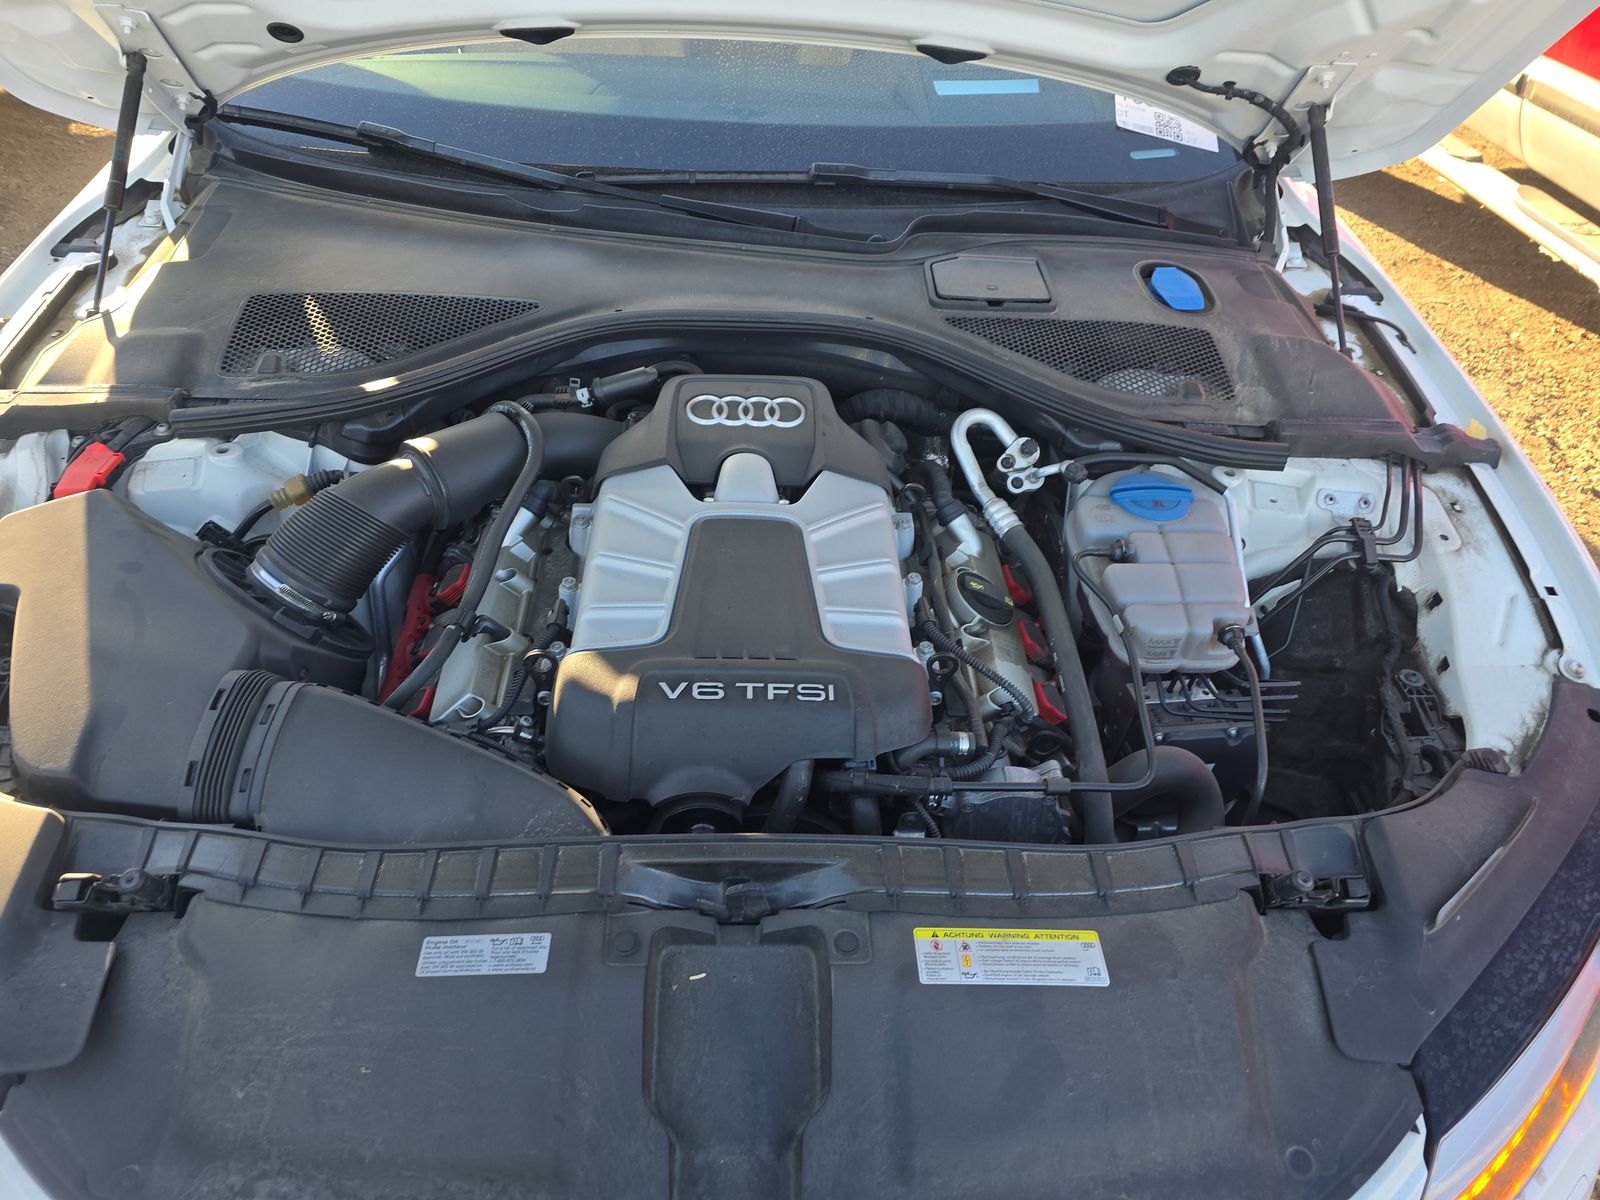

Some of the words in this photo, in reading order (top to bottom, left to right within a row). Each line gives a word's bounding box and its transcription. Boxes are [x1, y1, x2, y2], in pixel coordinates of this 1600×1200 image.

[658, 681, 725, 700] V6
[735, 682, 835, 702] TFSI
[989, 932, 1031, 940] WARNING
[1034, 932, 1080, 940] ATTENTION
